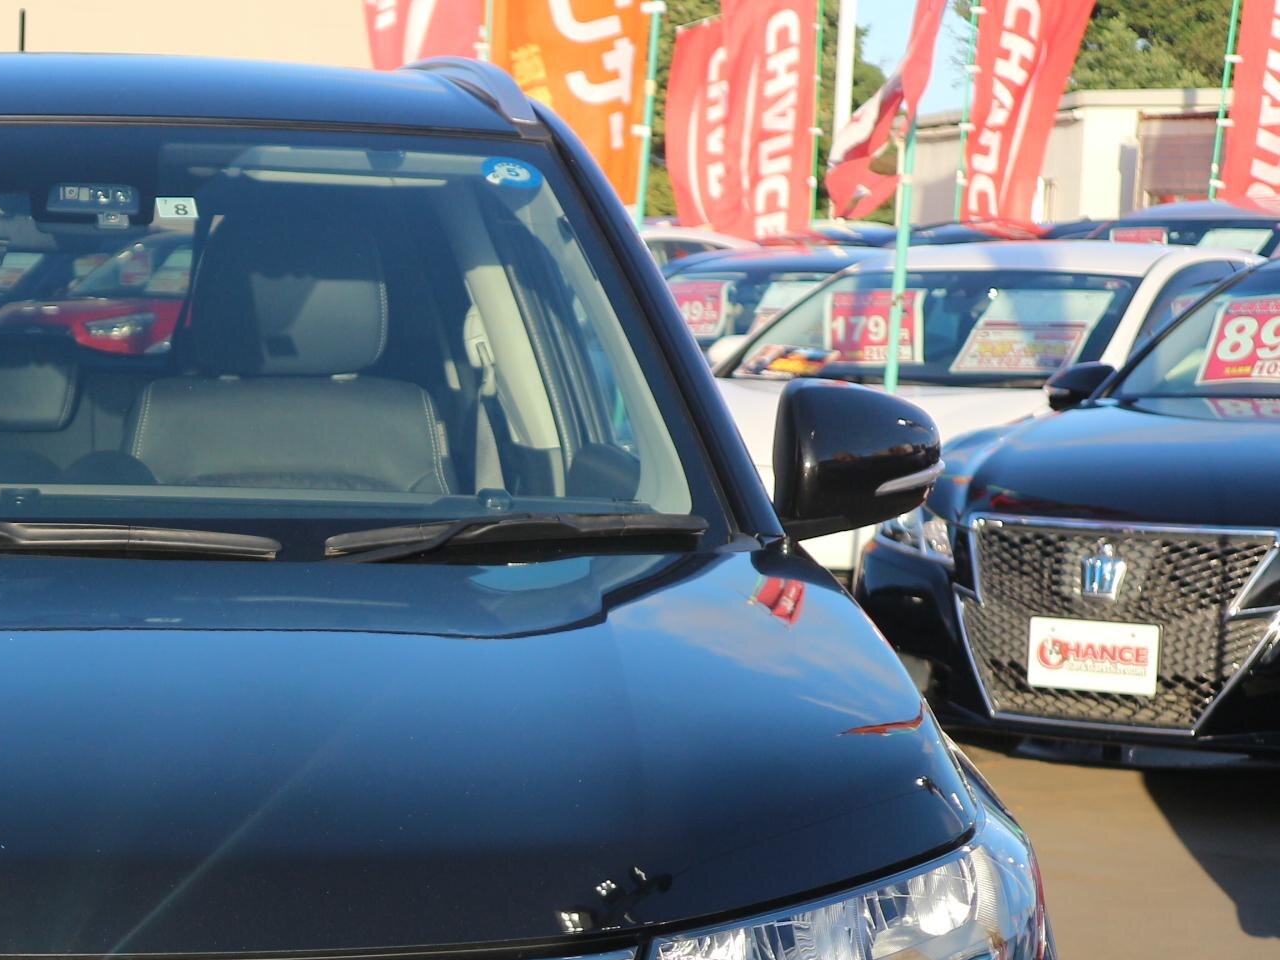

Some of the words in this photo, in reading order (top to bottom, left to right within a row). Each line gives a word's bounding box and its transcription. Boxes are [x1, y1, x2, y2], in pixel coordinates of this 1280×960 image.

[967, 0, 1040, 218] CHANC
[174, 203, 189, 216] 8
[831, 315, 887, 343] 179
